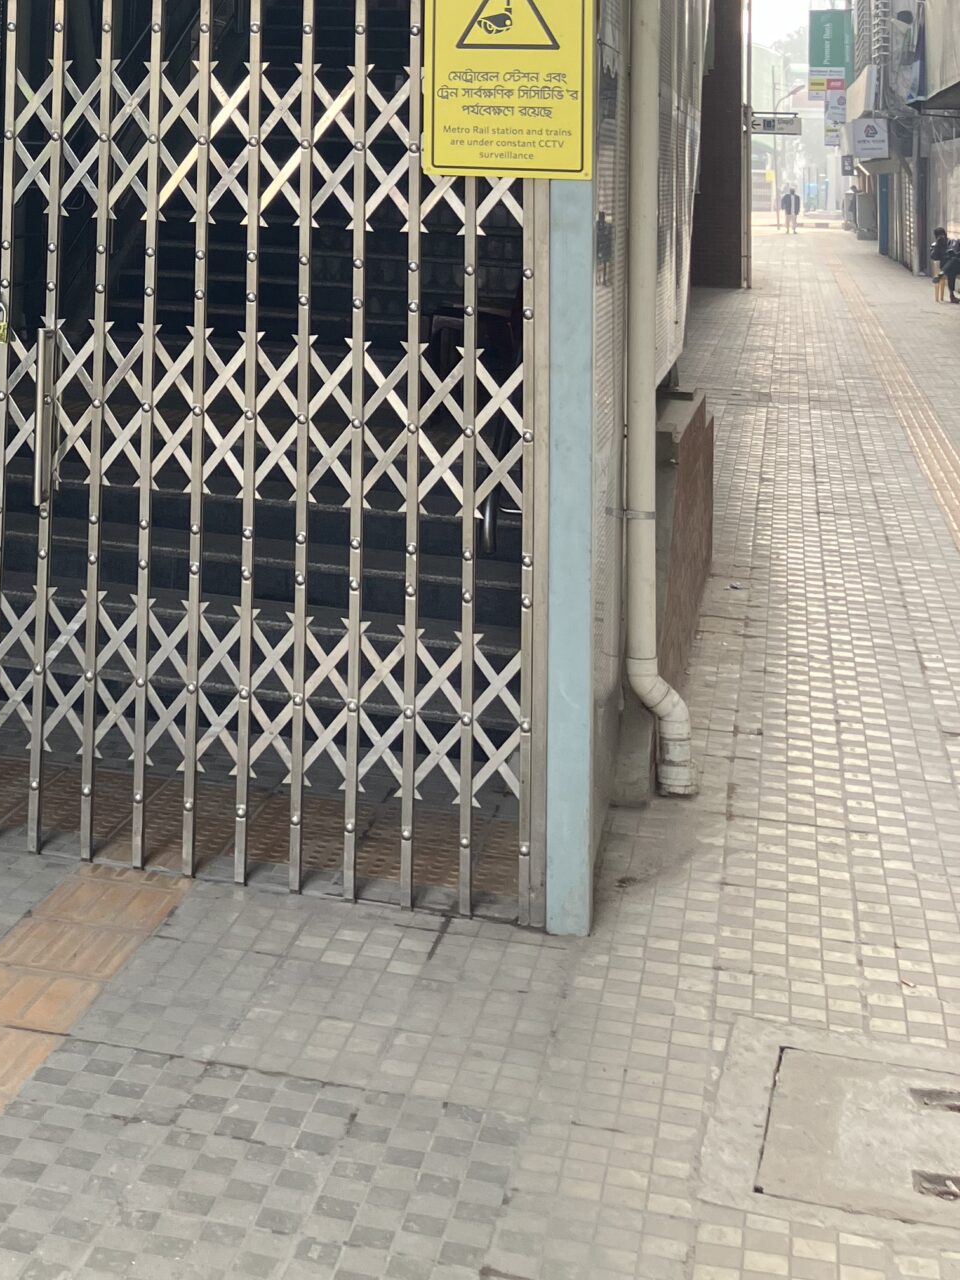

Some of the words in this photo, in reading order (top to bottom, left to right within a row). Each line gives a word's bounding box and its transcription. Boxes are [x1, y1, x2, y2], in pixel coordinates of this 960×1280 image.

[448, 68, 500, 84] মেট্রোরেল
[502, 68, 539, 83] স্টেশন
[543, 72, 568, 84] এবং
[436, 84, 459, 100] ট্রেন
[461, 85, 514, 100] সার্বক্ষণিক
[461, 102, 515, 117] পর্যবেক্ষণে
[518, 105, 553, 119] রয়েছে
[443, 125, 471, 134] Metro
[472, 125, 490, 134] Rail
[491, 127, 524, 136] station
[526, 127, 543, 136] and
[545, 128, 572, 137] trains
[467, 138, 494, 147] under
[496, 139, 537, 148] constant
[538, 140, 565, 148] CCTV
[479, 151, 535, 160] surveillance
